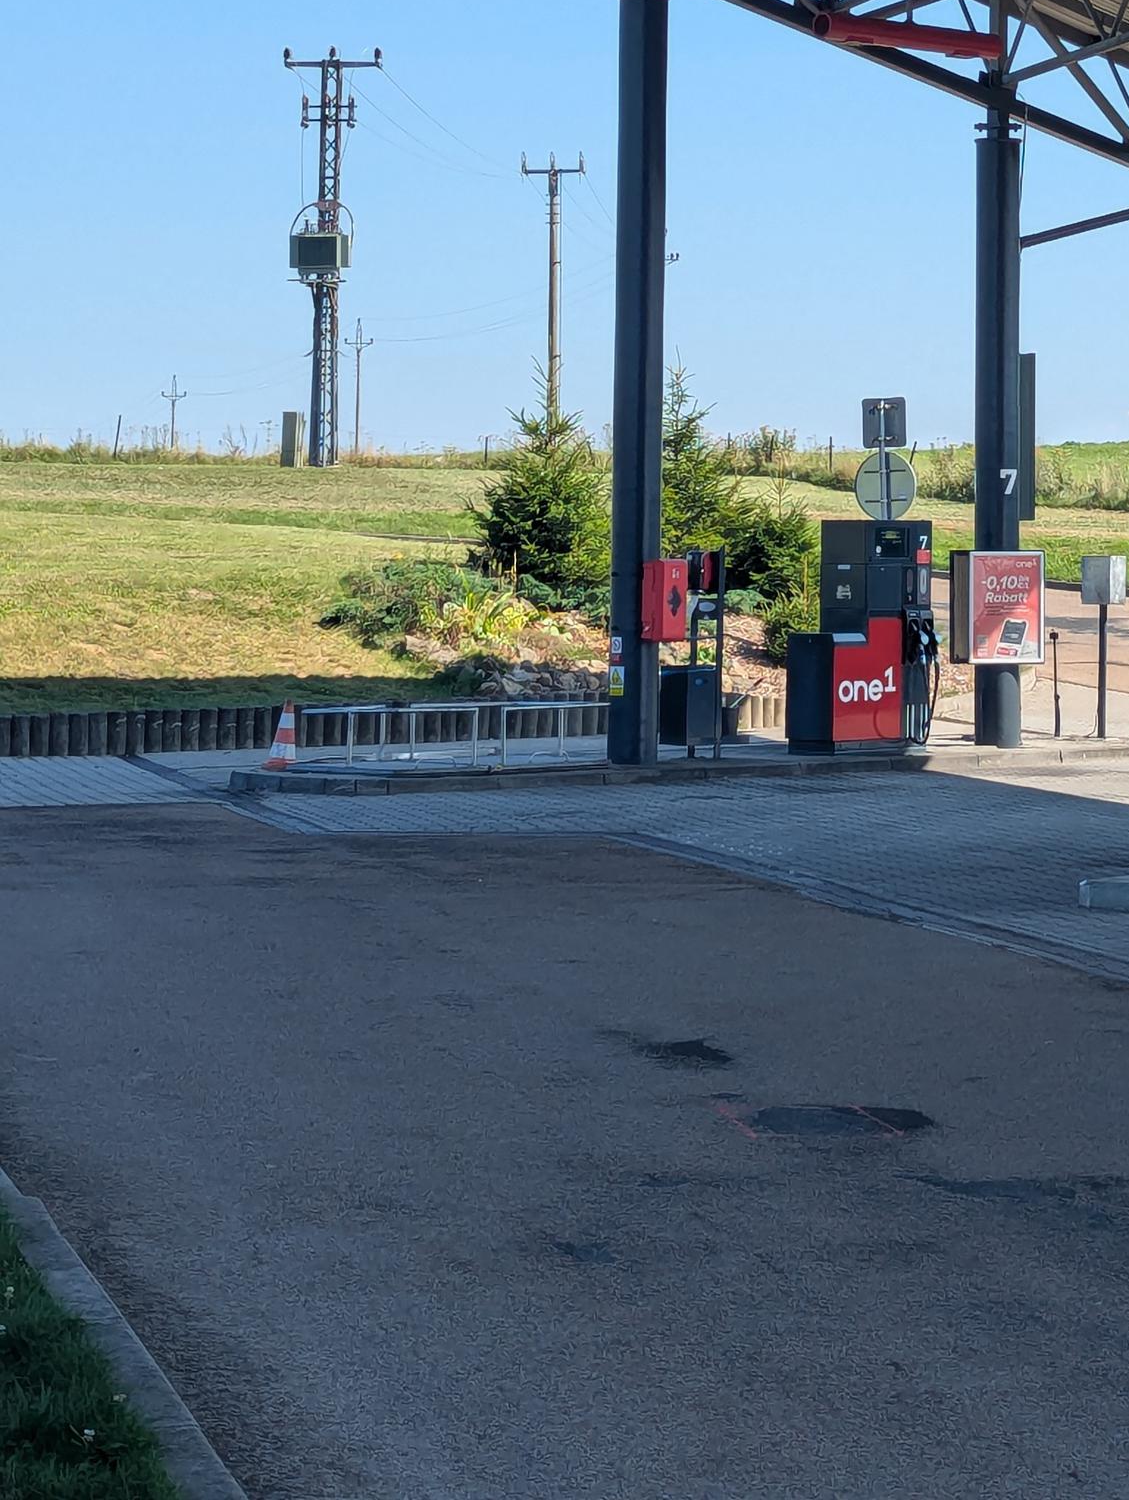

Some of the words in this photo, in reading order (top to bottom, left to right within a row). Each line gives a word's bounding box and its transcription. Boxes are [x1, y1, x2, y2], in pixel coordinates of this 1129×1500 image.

[1000, 468, 1017, 495] 7
[920, 535, 928, 550] 7
[985, 591, 1028, 603] Rabatt
